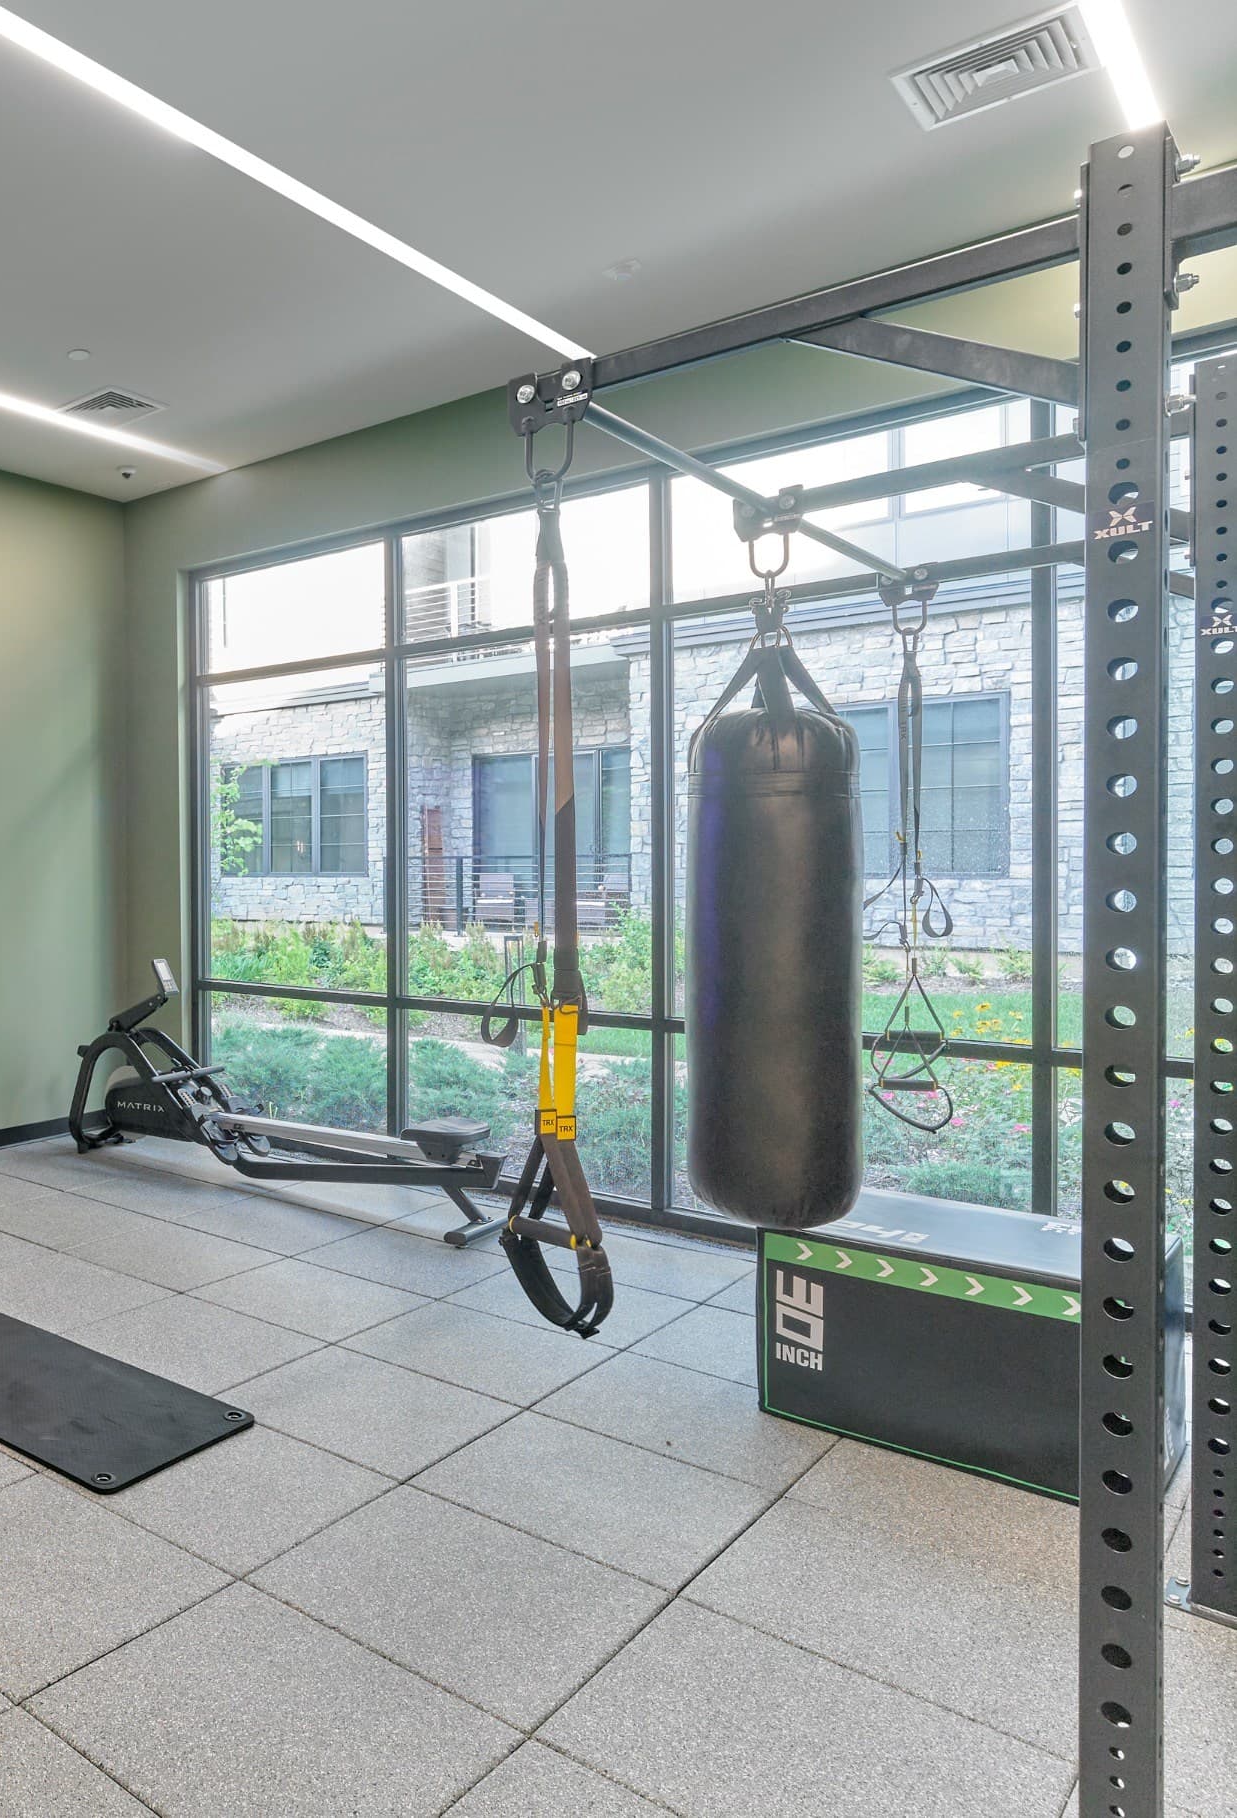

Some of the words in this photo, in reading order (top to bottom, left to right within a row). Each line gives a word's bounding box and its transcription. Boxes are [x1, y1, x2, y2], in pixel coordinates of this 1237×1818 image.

[1094, 520, 1153, 539] XULT
[117, 1101, 165, 1112] MATRIX
[542, 1119, 555, 1127] TRX
[559, 1125, 574, 1133] TRX
[775, 1342, 824, 1371] INCH
